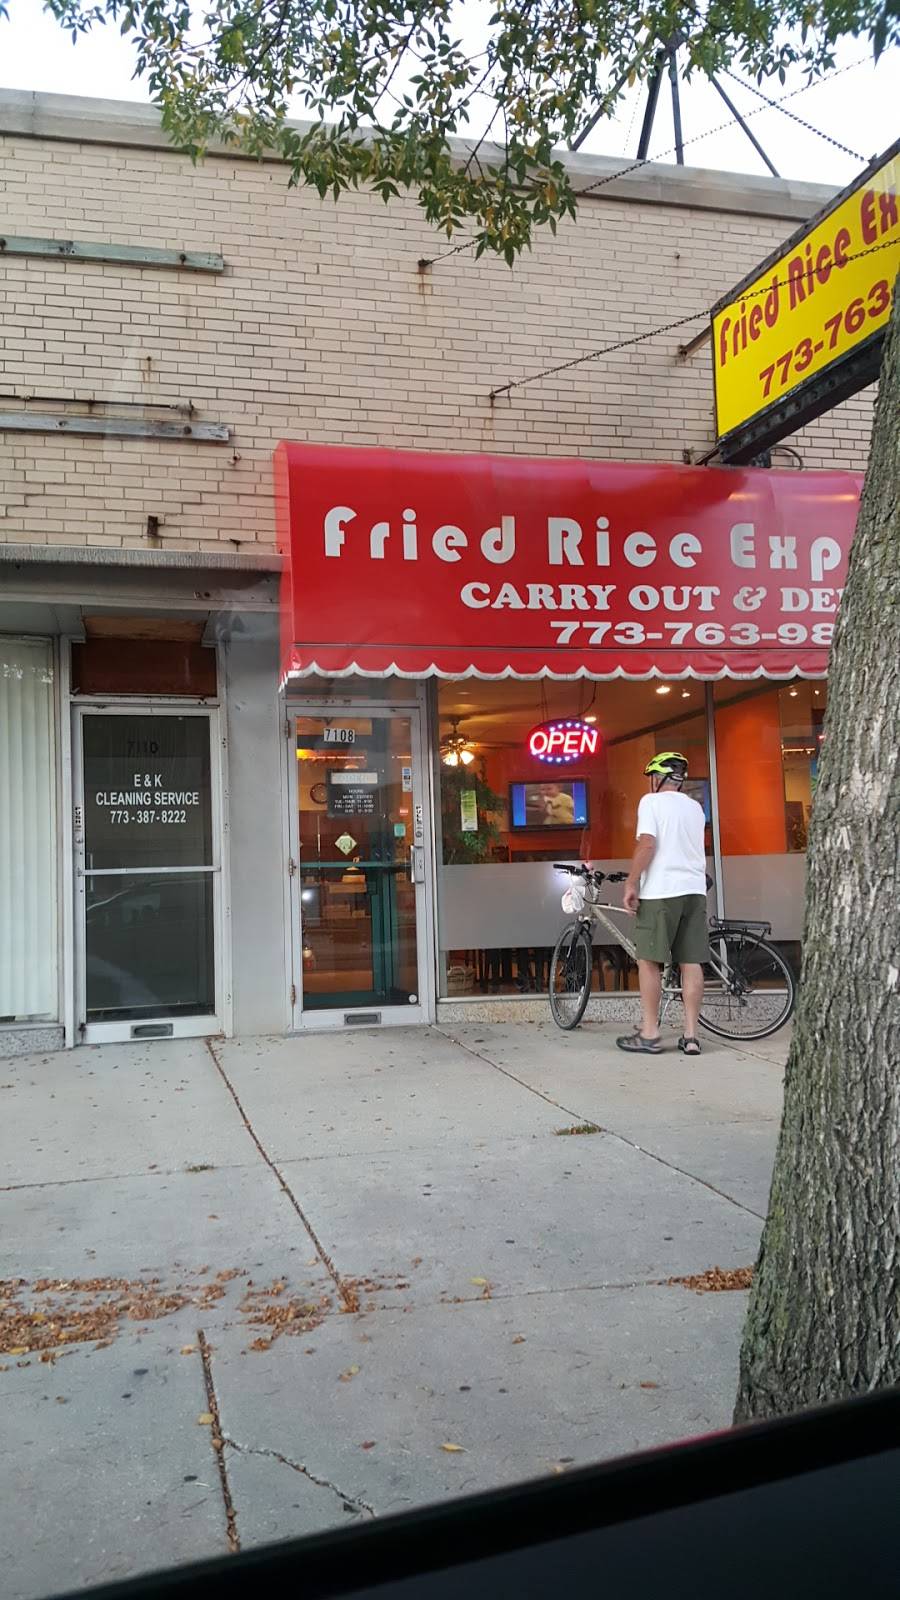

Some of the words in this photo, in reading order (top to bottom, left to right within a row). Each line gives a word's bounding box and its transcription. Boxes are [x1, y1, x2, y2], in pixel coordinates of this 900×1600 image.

[787, 227, 852, 311] Rice
[547, 516, 703, 568] Rice
[730, 522, 842, 582] Exp
[460, 582, 617, 611] CARRY
[628, 584, 721, 612] OUT
[733, 586, 768, 612] &
[325, 728, 354, 742] 7108
[529, 730, 599, 754] OPEN
[134, 774, 142, 787] E
[143, 774, 152, 787] &
[154, 774, 162, 787] K
[95, 791, 151, 806] CLEANING
[153, 791, 200, 806] SERVICE
